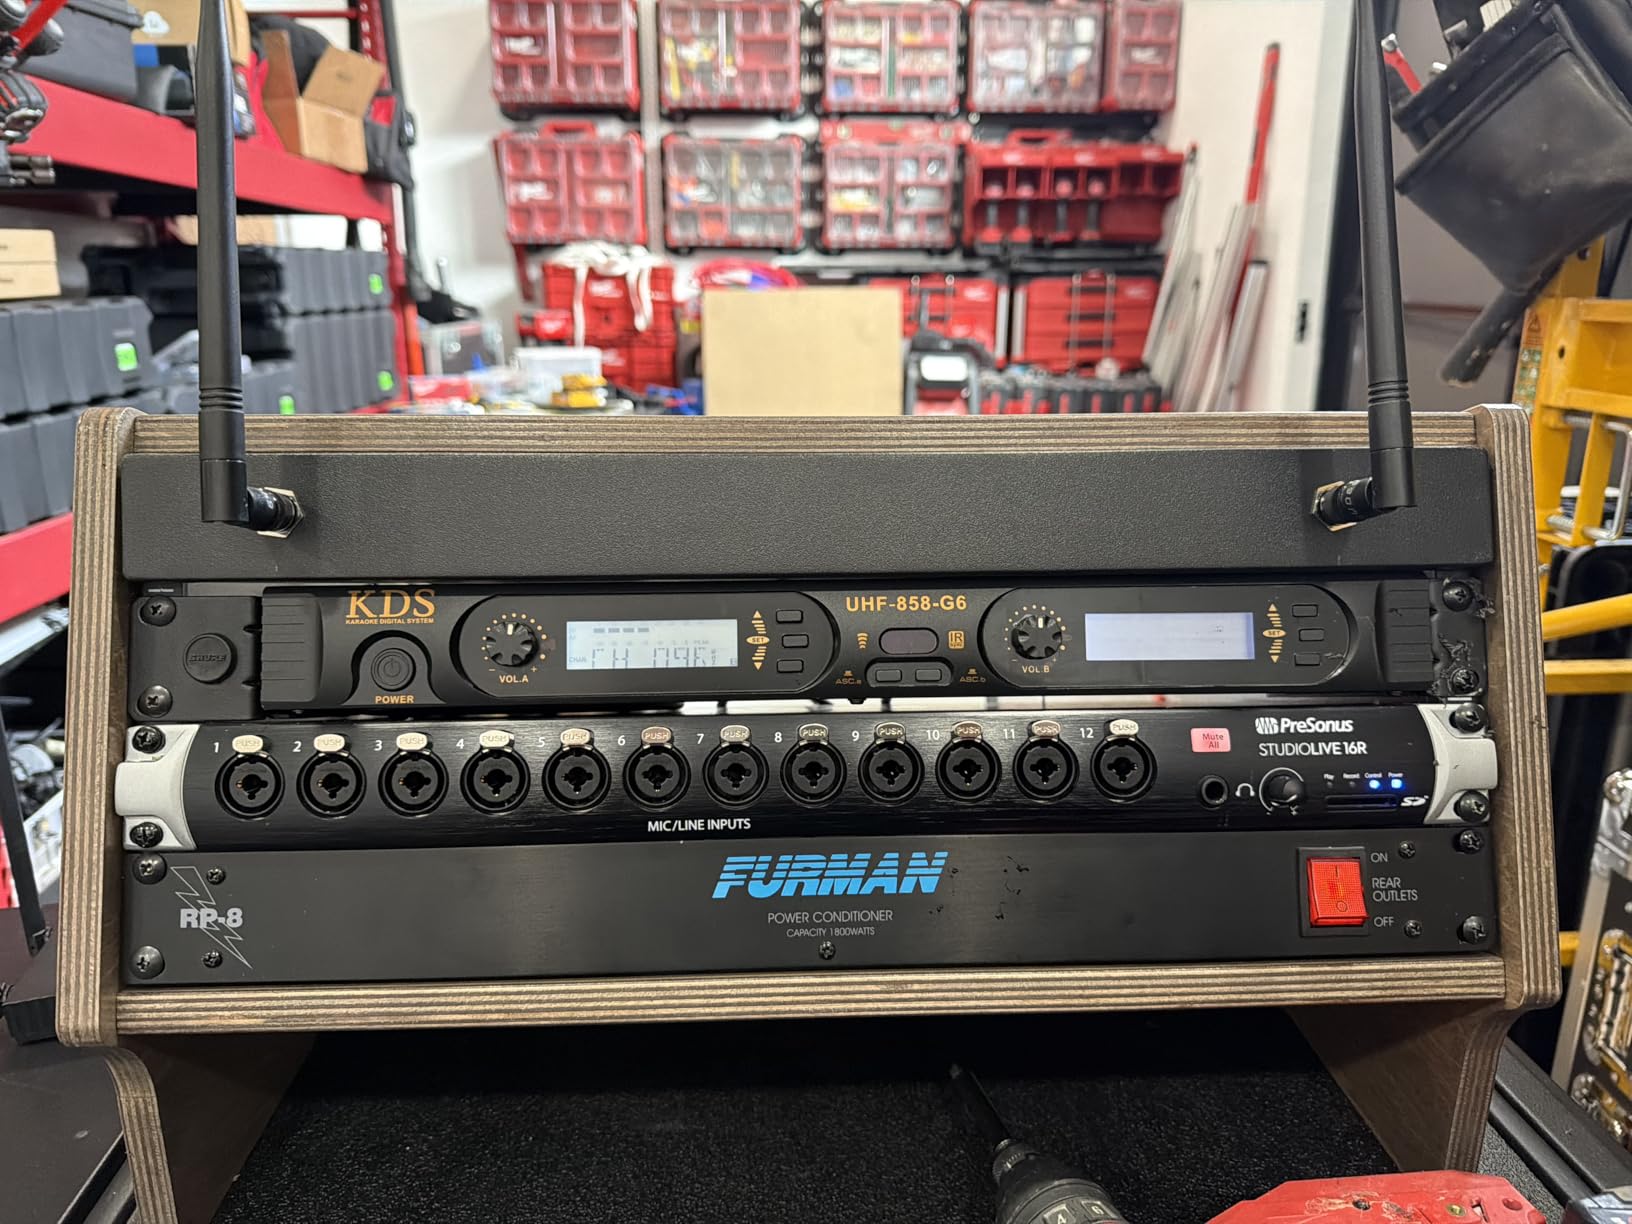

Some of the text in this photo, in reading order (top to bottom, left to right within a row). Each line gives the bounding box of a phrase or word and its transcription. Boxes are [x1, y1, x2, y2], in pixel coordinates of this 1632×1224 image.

[345, 588, 436, 618] KDS
[846, 595, 967, 611] UHF-858-G6
[406, 617, 434, 625] SYSTEM
[1021, 665, 1050, 674] VOL.B
[499, 674, 529, 684] VOL.A
[375, 695, 415, 704] POWER
[956, 726, 981, 735] PUSH
[1034, 724, 1058, 734] PUSH
[1112, 723, 1137, 732] PUSH
[1280, 717, 1354, 734] PreSonus
[563, 733, 587, 741] PUSH
[644, 731, 669, 740] PUSH
[724, 730, 748, 739] PUSH
[802, 728, 827, 737] PUSH
[852, 730, 860, 742] 9
[879, 727, 903, 736] PUSH
[926, 729, 940, 741] 10
[1003, 728, 1016, 739] 11
[1079, 726, 1094, 739] 12
[1202, 732, 1224, 742] Mute
[399, 737, 425, 745] PUSH
[482, 735, 509, 743] PUSH
[537, 737, 545, 748] 5
[617, 735, 626, 746] 6
[697, 733, 705, 745] 7
[774, 732, 782, 743] 8
[214, 742, 220, 752] 1
[293, 741, 302, 752] 2
[374, 739, 383, 751] 3
[456, 738, 465, 749] 4
[1208, 741, 1220, 749] All
[1258, 741, 1369, 757] STUDIOLIVE 16R
[647, 818, 751, 833] MIC/LINE INPUTS
[1370, 852, 1388, 863] ON
[712, 851, 949, 899] FURMAN
[1372, 877, 1401, 889] REAR
[1372, 889, 1418, 902] OUTLETS
[180, 907, 243, 929] RP-8
[767, 909, 893, 925] POWER CONDITIONER
[1374, 916, 1394, 928] OFF
[786, 927, 827, 938] CAPACITY
